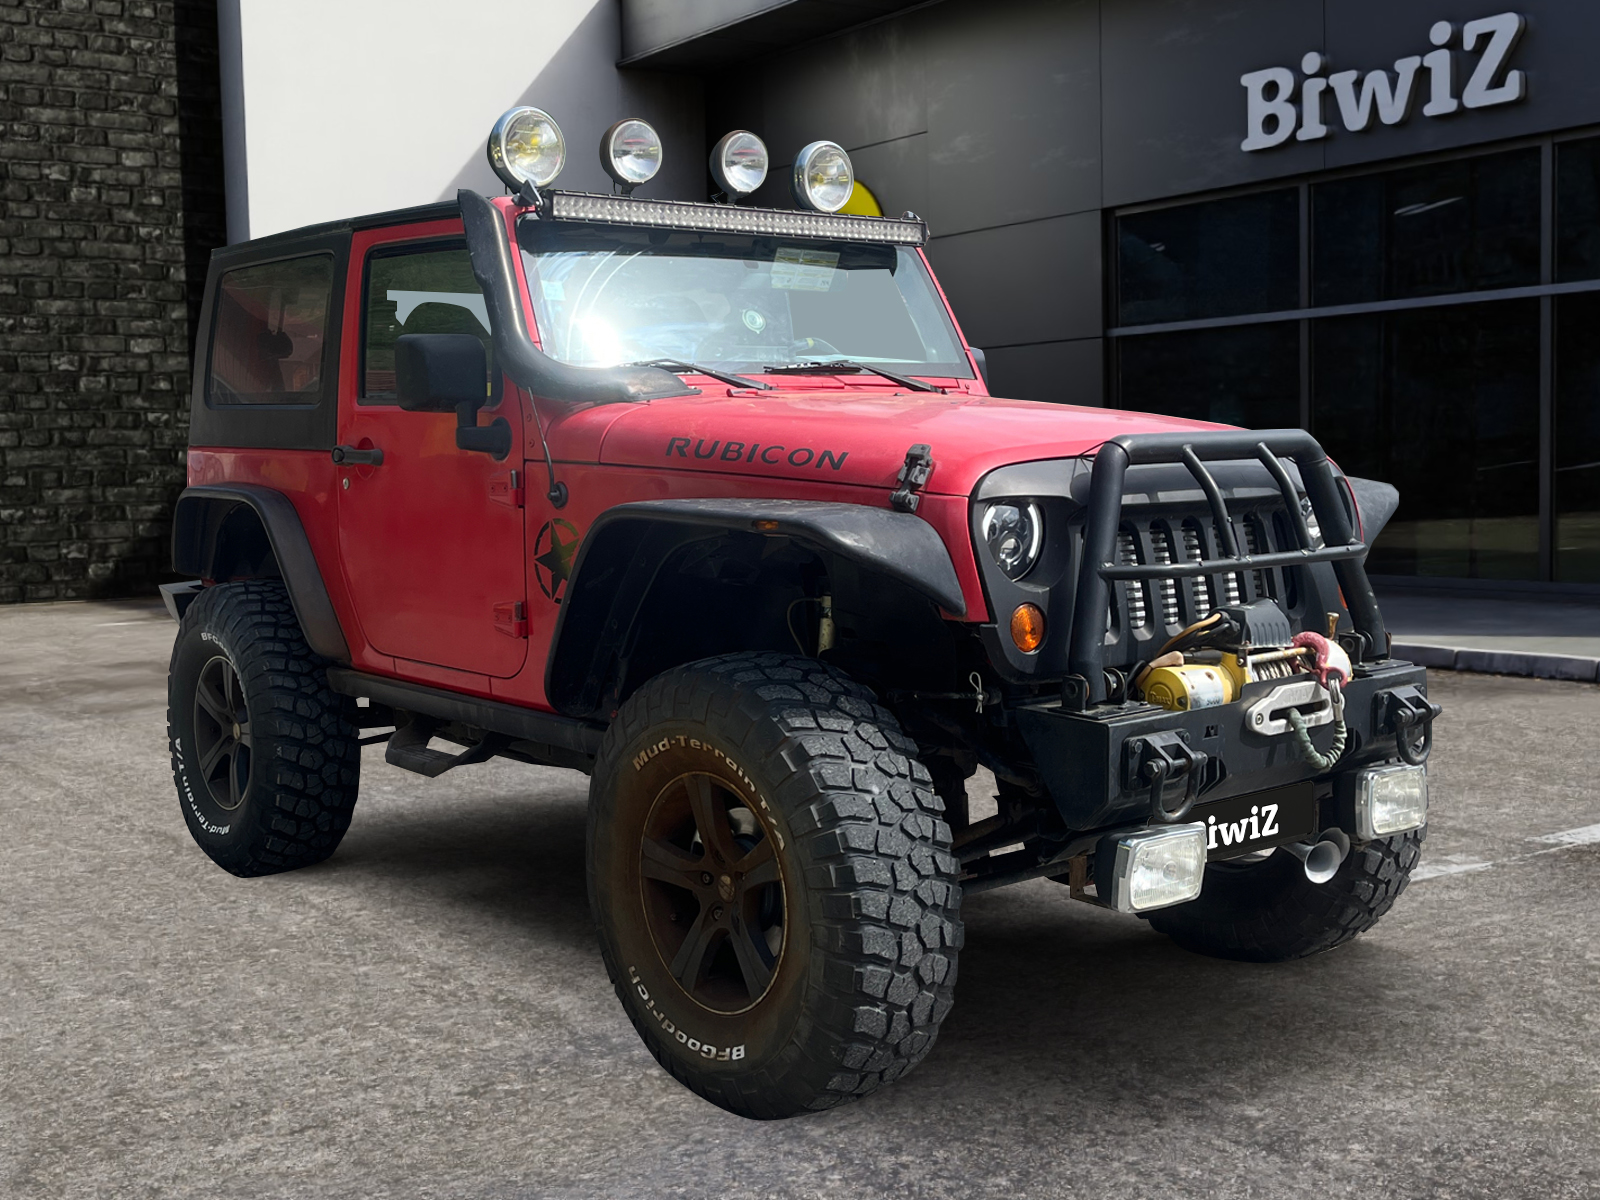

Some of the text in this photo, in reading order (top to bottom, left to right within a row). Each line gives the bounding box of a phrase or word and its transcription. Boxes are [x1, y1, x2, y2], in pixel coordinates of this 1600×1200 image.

[1240, 12, 1525, 152] BiwiZ
[665, 437, 849, 471] RUBICON
[182, 775, 231, 835] Mud-Terrain
[632, 735, 785, 850] Mud-Terrain T/A
[1187, 803, 1279, 850] iwiZ
[628, 965, 745, 1061] BFGoodrich
